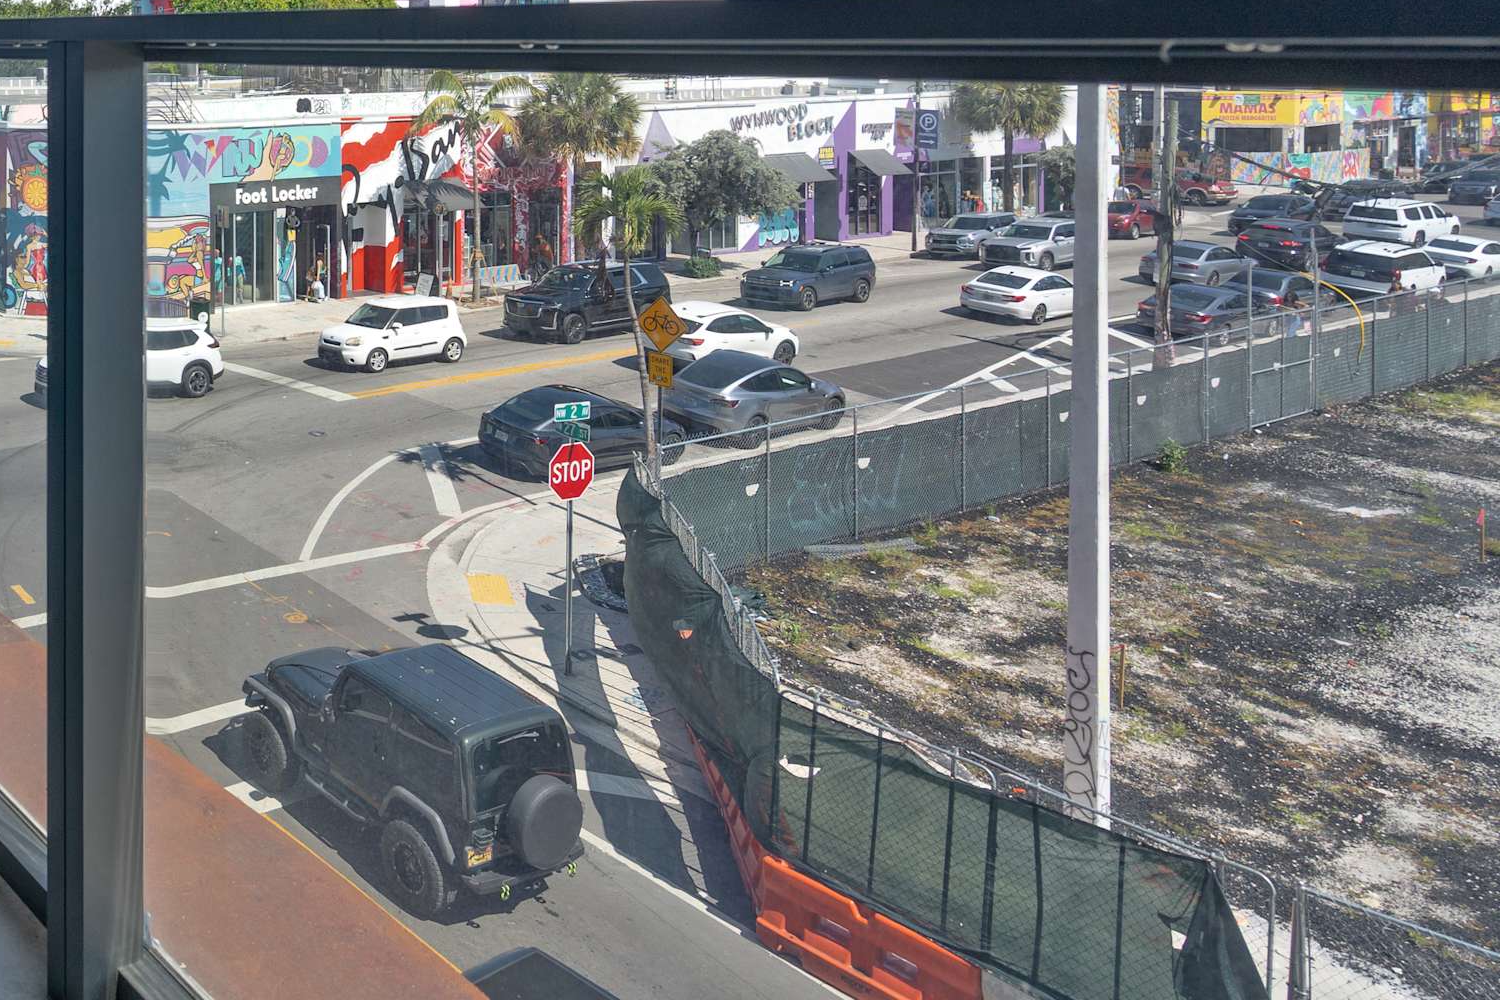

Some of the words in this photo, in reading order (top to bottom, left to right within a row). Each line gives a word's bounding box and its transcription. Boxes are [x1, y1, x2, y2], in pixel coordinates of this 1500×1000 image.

[730, 103, 808, 133] WYNWOOD
[1219, 103, 1276, 114] MAMAS
[787, 116, 835, 143] BLOCK
[235, 187, 268, 206] Foot
[271, 184, 319, 204] Locker
[556, 408, 567, 418] NW
[570, 405, 578, 419] 2
[564, 424, 576, 436] 27
[580, 429, 588, 439] ST
[552, 459, 591, 484] STOP
